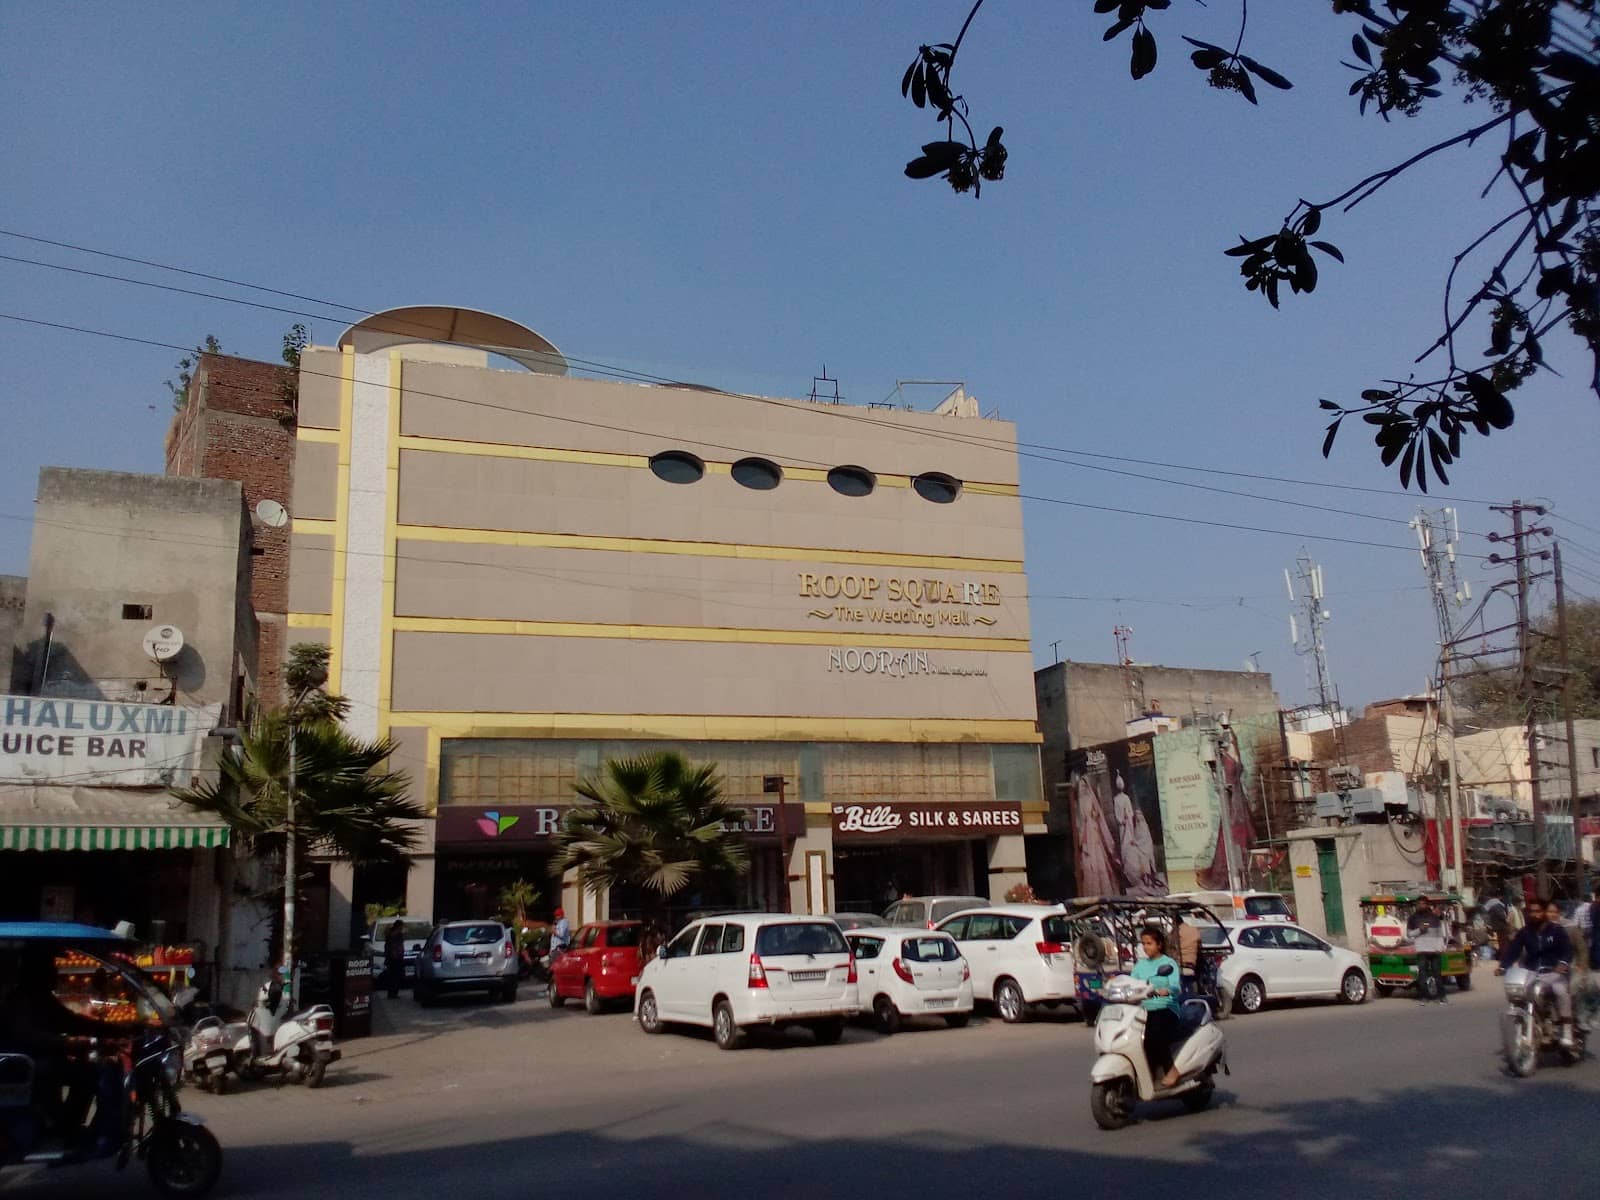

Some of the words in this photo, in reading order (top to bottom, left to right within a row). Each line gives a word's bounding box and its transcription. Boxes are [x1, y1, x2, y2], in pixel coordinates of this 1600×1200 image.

[799, 573, 880, 600] ROOP
[887, 578, 1001, 608] SQUARE
[835, 606, 864, 622] The
[868, 608, 935, 628] Wedding
[938, 610, 970, 626] Mall
[827, 648, 931, 678] NOORAN
[87, 736, 146, 759] BAR
[839, 806, 902, 832] Billa
[909, 811, 944, 827] SILK
[947, 811, 959, 827] &
[962, 810, 1020, 827] SAREES
